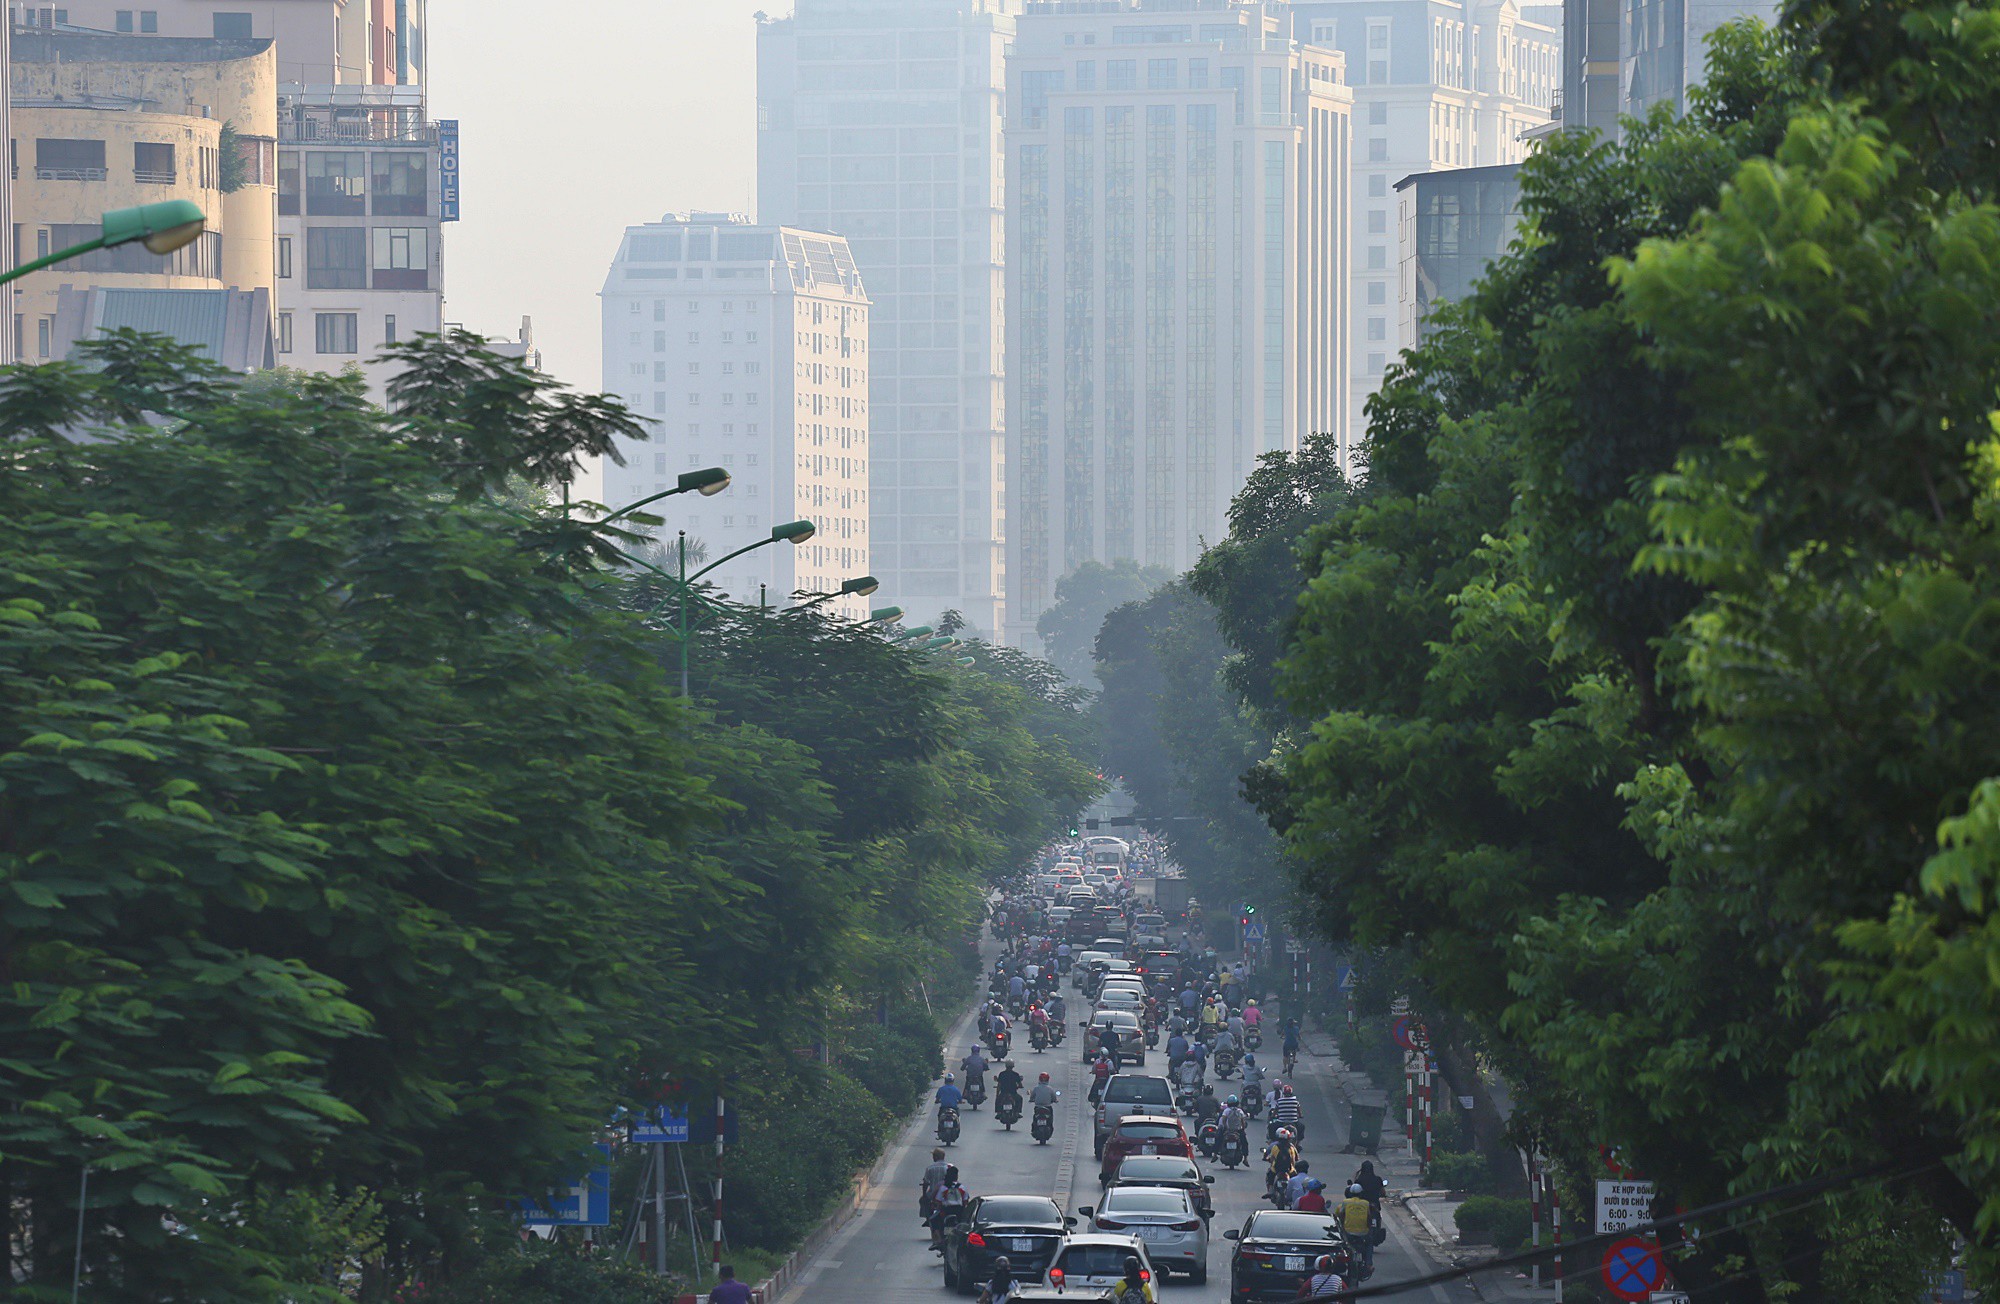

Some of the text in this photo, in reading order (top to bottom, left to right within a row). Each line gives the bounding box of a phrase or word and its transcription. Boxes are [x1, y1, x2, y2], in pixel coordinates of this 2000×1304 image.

[442, 140, 457, 218] HOTEL
[1612, 1186, 1621, 1194] XE
[1622, 1185, 1635, 1195] HỢP
[1609, 1209, 1627, 1219] 6:00
[1603, 1222, 1627, 1232] 16:30
